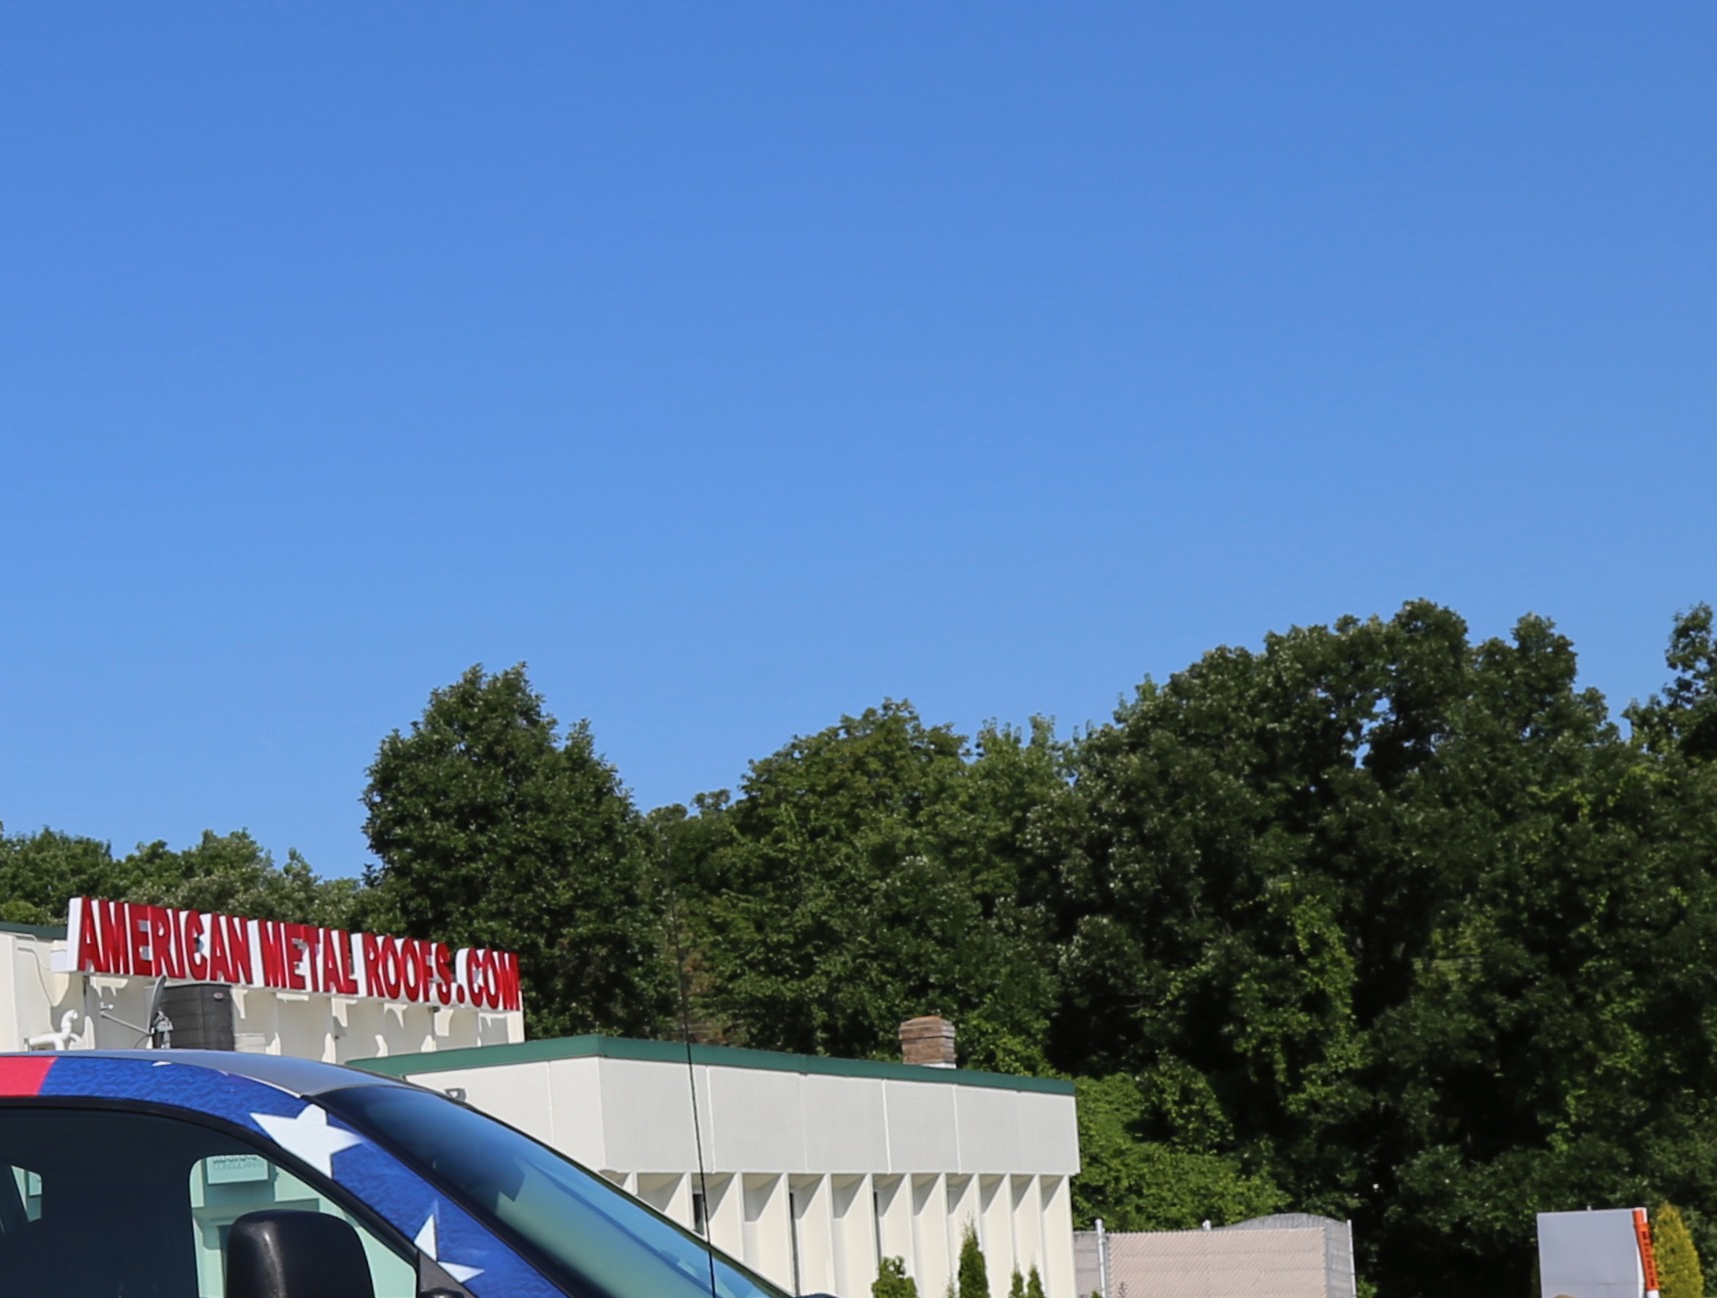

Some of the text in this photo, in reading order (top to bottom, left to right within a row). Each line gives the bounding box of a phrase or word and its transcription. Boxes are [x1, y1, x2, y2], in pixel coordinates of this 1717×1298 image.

[77, 896, 521, 1012] AMERICAN METAL ROOFS.COM
